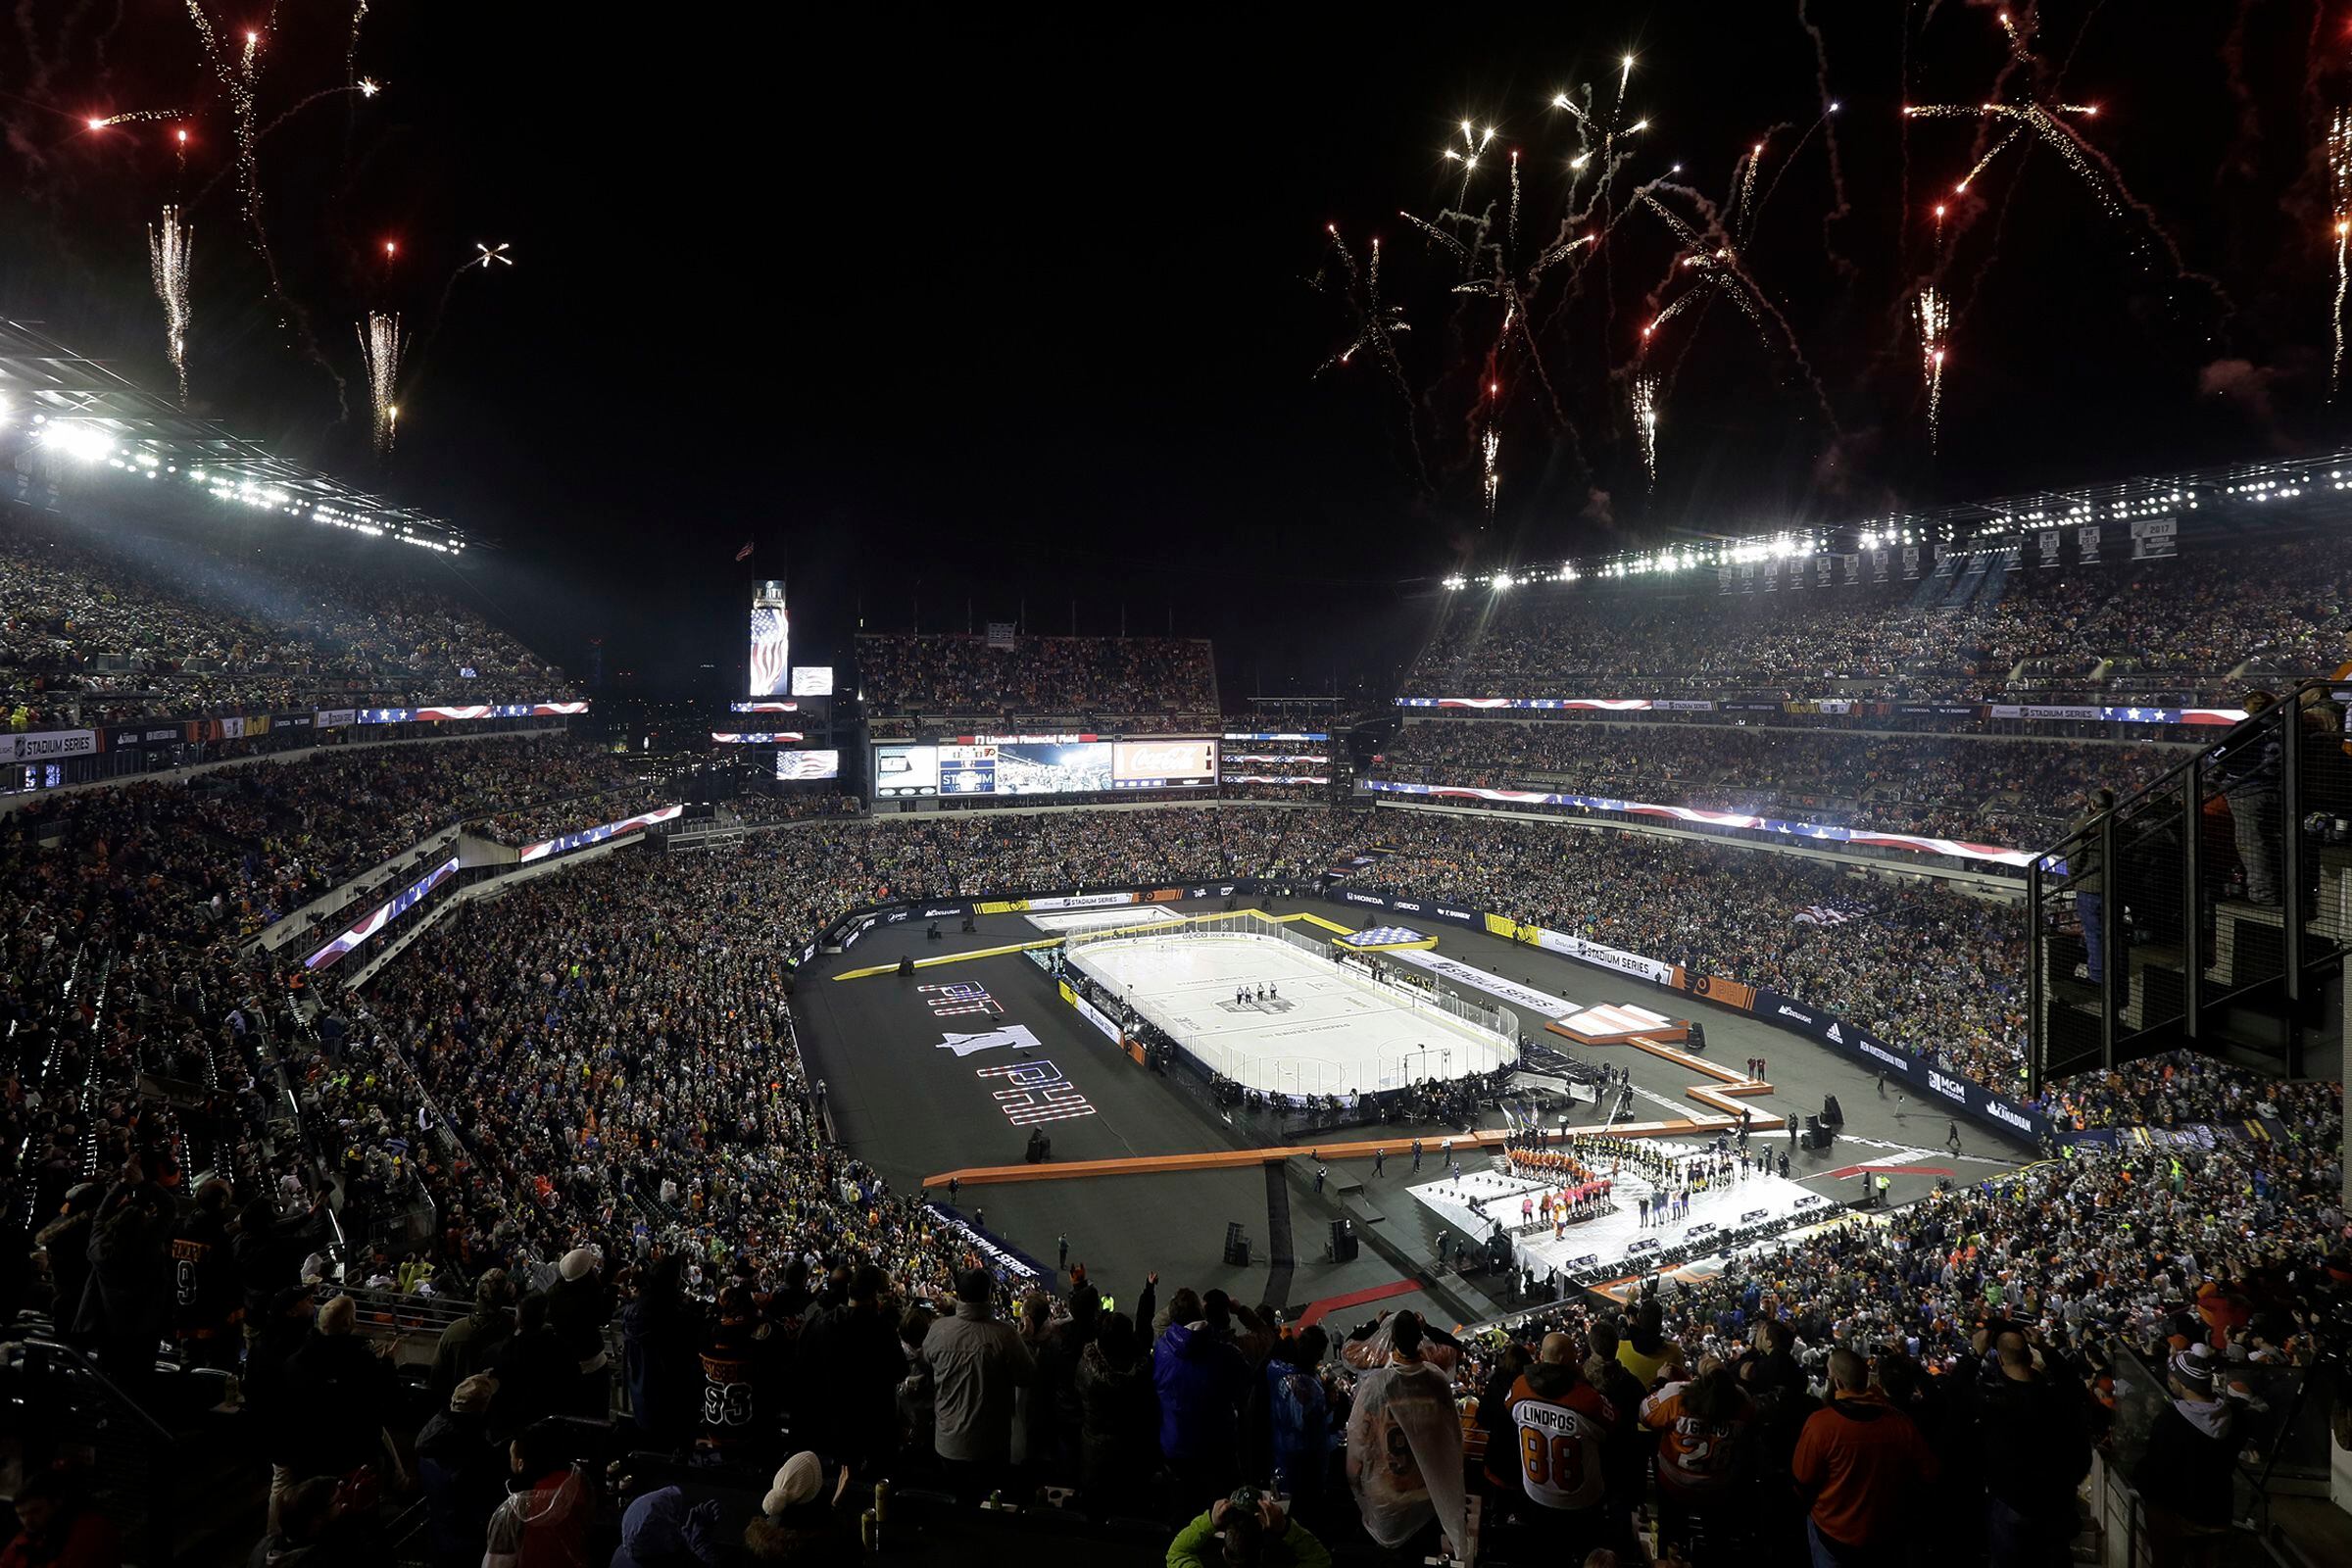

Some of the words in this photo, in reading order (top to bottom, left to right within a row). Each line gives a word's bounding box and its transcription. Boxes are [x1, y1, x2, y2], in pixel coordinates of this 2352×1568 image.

[2150, 524, 2171, 534] 2017
[2030, 709, 2064, 717] STADIUM
[2065, 710, 2093, 718] SERIES
[26, 739, 63, 756] STADIUM
[64, 736, 90, 753] SERIES
[986, 735, 1018, 745] Lincoln
[1019, 735, 1056, 745] Financial
[1058, 735, 1079, 744] Field
[1071, 898, 1097, 906] STADIUM
[1098, 896, 1118, 905] SERIES
[1354, 894, 1384, 906] HONDA
[1397, 902, 1420, 911] GEICO
[1587, 947, 1620, 965] STADIUM
[1622, 957, 1649, 974] SERIES
[917, 980, 1004, 1015] PIT
[1445, 966, 1502, 990] STADIUM
[1500, 988, 1552, 1007] SERIES
[1716, 981, 1743, 1005] PHI
[976, 1059, 1097, 1126] PHI
[1941, 1075, 1965, 1096] MGM
[1941, 1087, 1966, 1103] RESORTS
[1997, 1106, 2032, 1132] CANADIAN
[960, 1227, 1004, 1257] STADIUM
[994, 1253, 1035, 1278] SERIES
[177, 1259, 196, 1305] 9
[1523, 1405, 1576, 1431] LINDROS
[1520, 1424, 1586, 1493] 88
